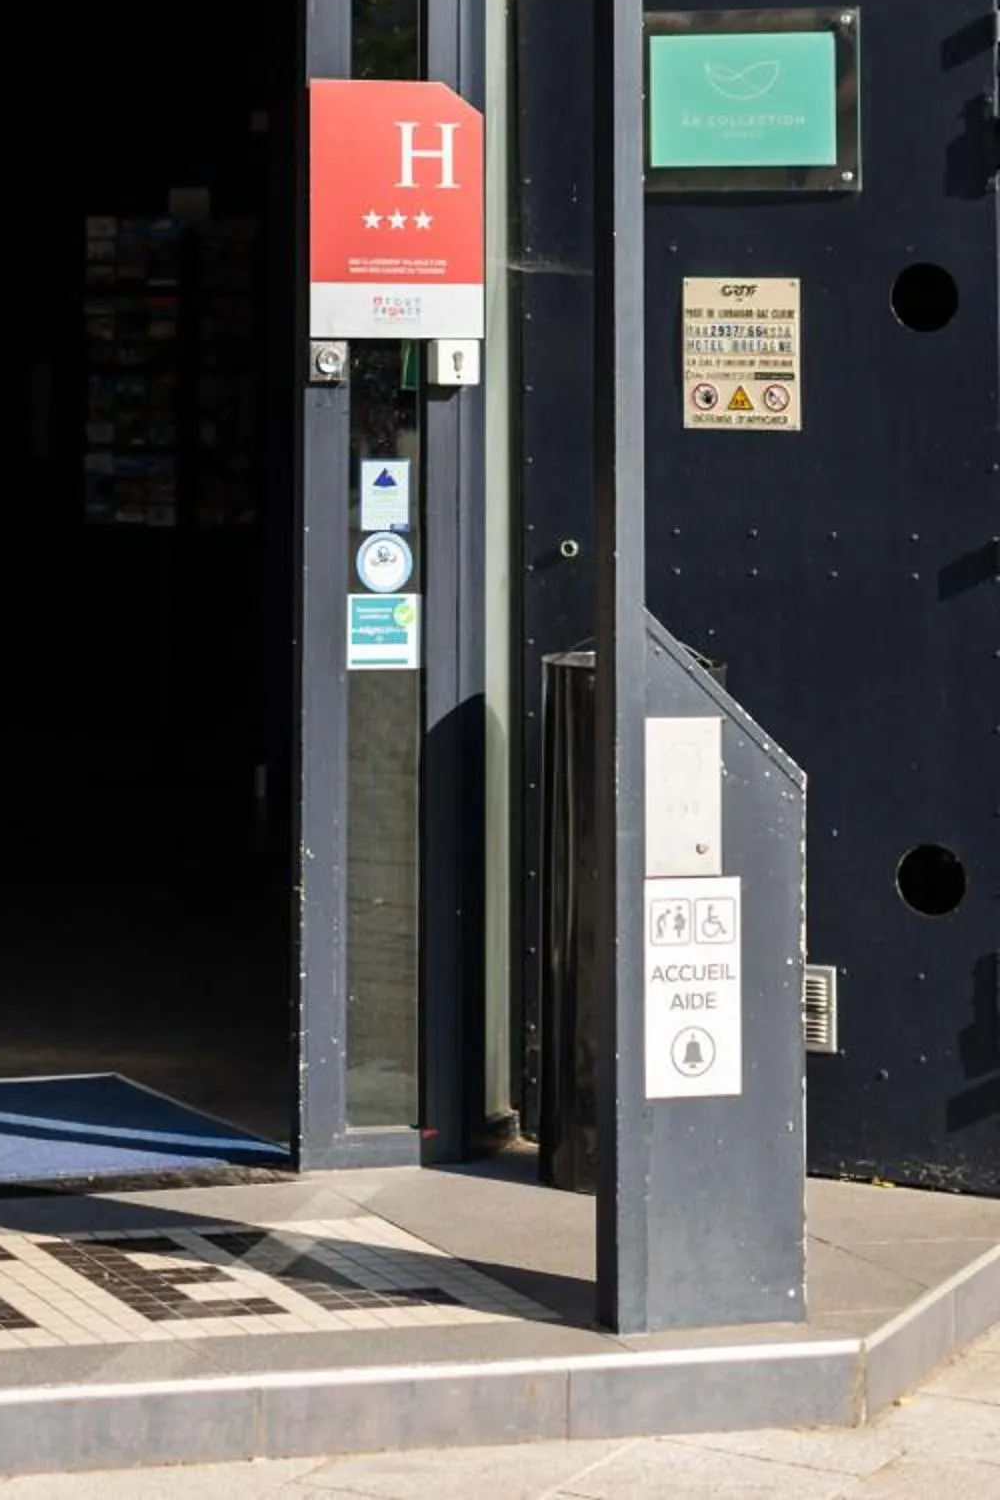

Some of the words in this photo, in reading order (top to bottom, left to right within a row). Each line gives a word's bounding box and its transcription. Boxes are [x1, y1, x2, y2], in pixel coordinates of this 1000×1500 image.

[395, 121, 461, 189] H
[650, 963, 736, 983] ACCUEIL
[669, 992, 718, 1010] AIDE
